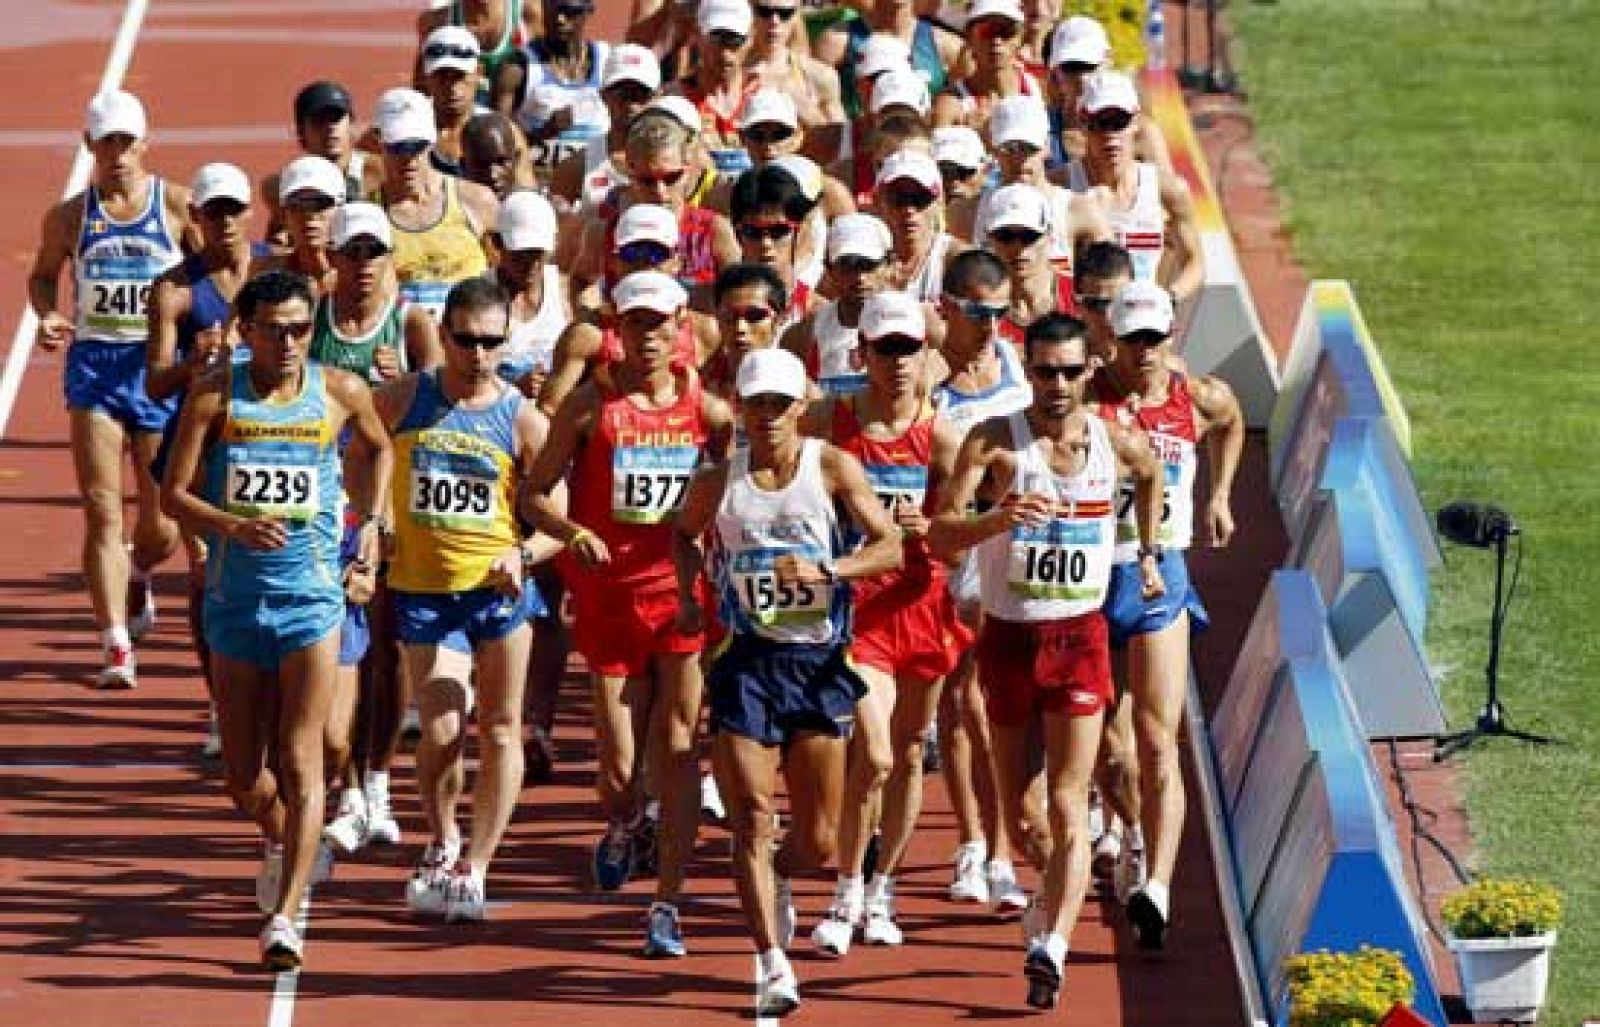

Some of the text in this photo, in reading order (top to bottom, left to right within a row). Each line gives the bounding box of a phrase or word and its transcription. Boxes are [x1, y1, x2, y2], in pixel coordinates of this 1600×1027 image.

[233, 468, 310, 503] 2239
[624, 474, 690, 507] 1377
[1026, 546, 1087, 582] 1610
[744, 576, 815, 610] 1555
